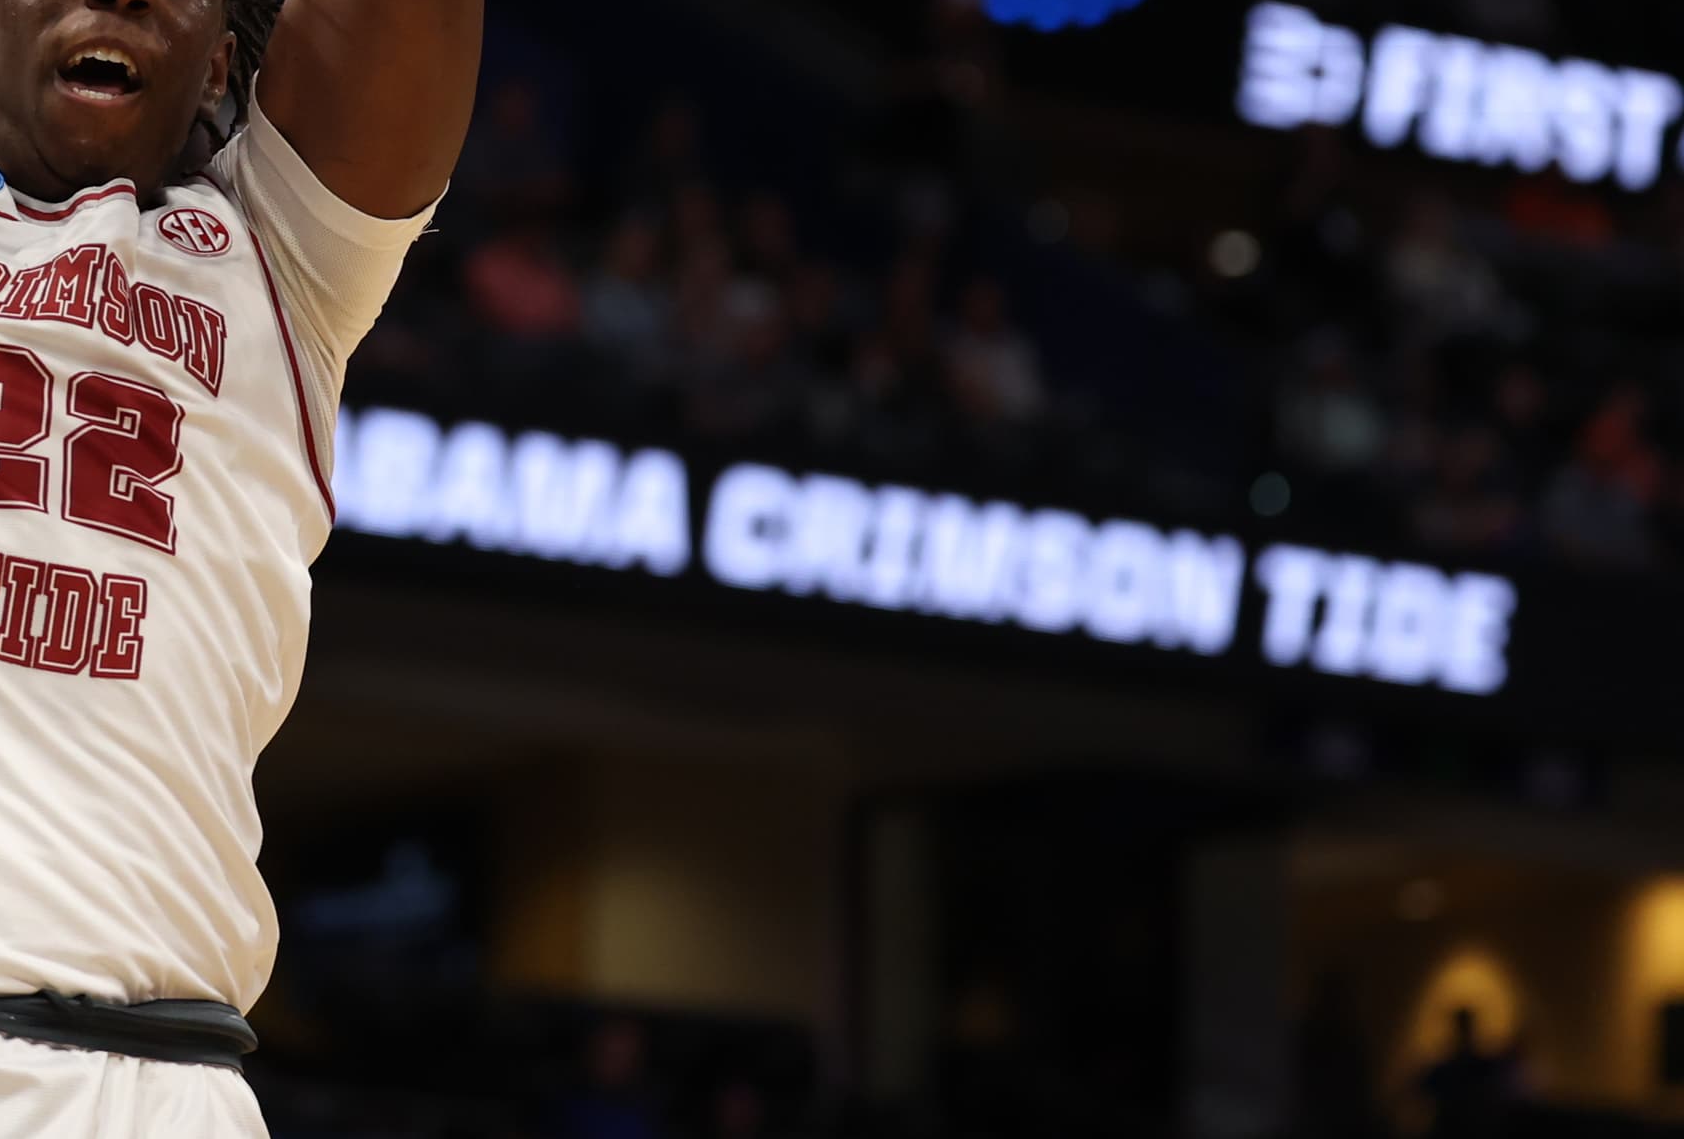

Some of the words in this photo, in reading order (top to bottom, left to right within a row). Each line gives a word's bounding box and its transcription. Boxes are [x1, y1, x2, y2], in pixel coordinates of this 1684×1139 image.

[1361, 23, 1683, 192] FIRST
[162, 211, 226, 252] SEC
[331, 403, 691, 577] BAMA
[702, 462, 1246, 657] CRIMSON
[1254, 542, 1517, 696] TIDE
